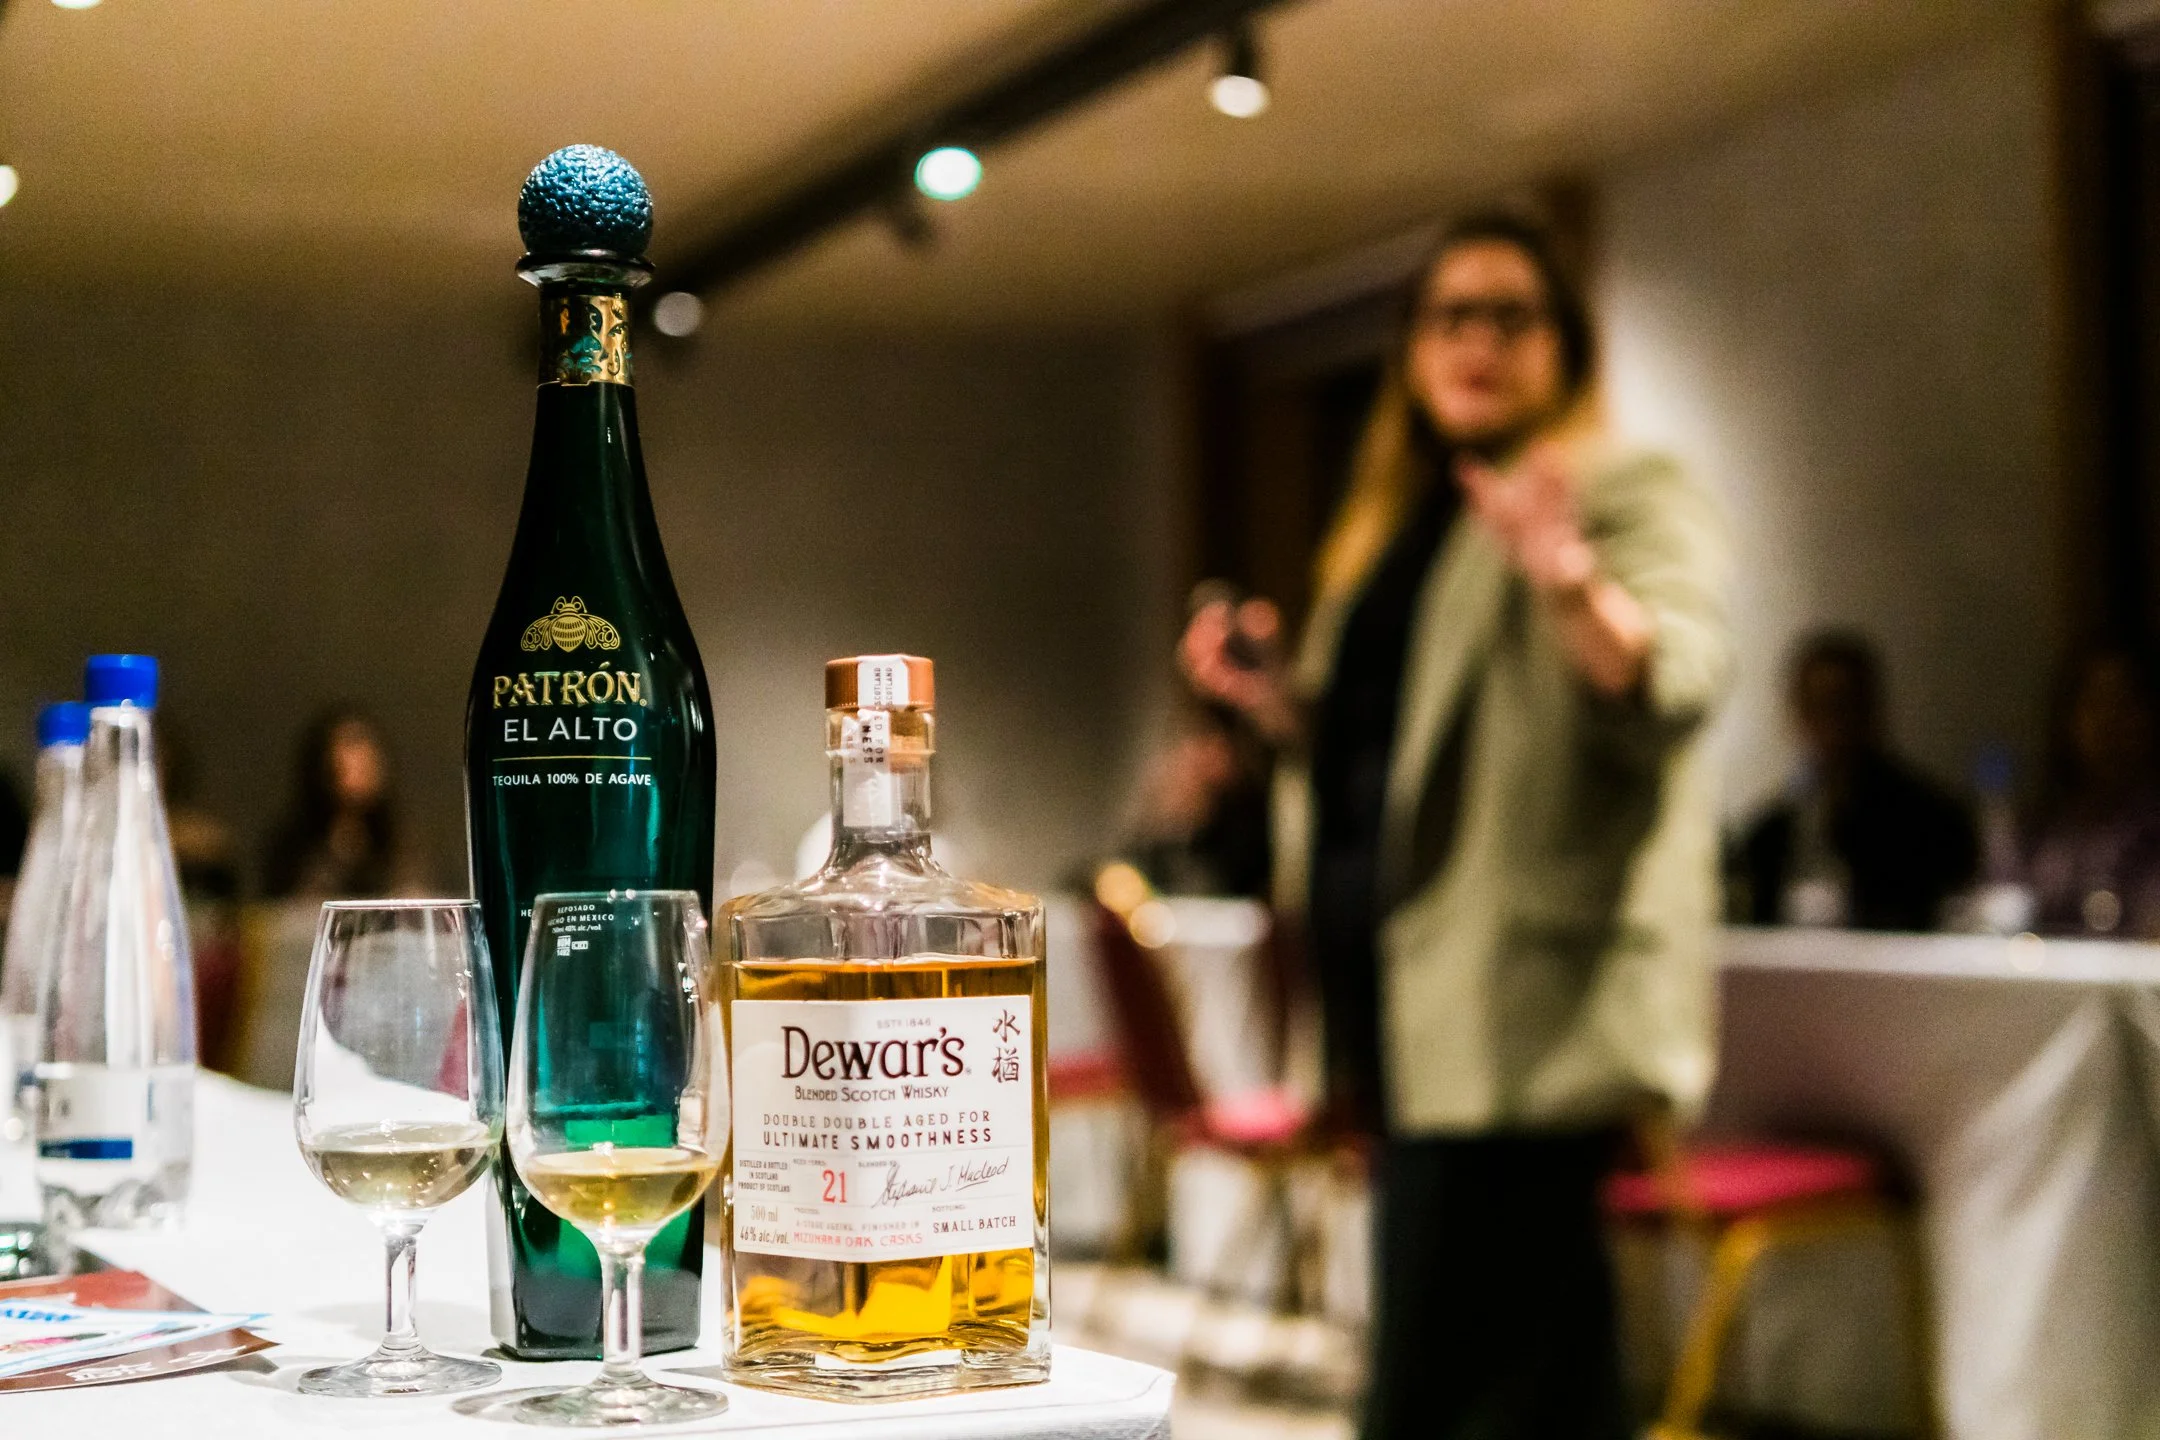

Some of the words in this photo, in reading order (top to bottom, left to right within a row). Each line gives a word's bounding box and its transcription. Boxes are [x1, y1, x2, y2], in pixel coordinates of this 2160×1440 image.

[493, 661, 642, 709] PATRÓN
[504, 718, 538, 742] EL
[548, 716, 638, 741] ALTO
[492, 774, 541, 787] TEQUILA
[547, 773, 579, 785] 100%
[585, 773, 603, 784] DE
[609, 773, 652, 786] AGAVE
[566, 915, 577, 923] EN
[579, 913, 615, 922] MEXICO
[780, 1026, 966, 1081] Dewar's
[763, 1113, 816, 1128] DOUBLE
[823, 1115, 893, 1130] DOUBLE
[903, 1113, 950, 1128] AGED
[958, 1110, 991, 1123] FOR
[763, 1130, 839, 1150] ULTIMATE
[850, 1127, 993, 1151] SMOOTHNESS
[821, 1169, 848, 1204] 21
[768, 1206, 778, 1222] ml
[740, 1226, 757, 1242] 46%
[932, 1219, 974, 1235] SMALL
[978, 1215, 1017, 1231] BATCH
[879, 1232, 923, 1247] CASKS
